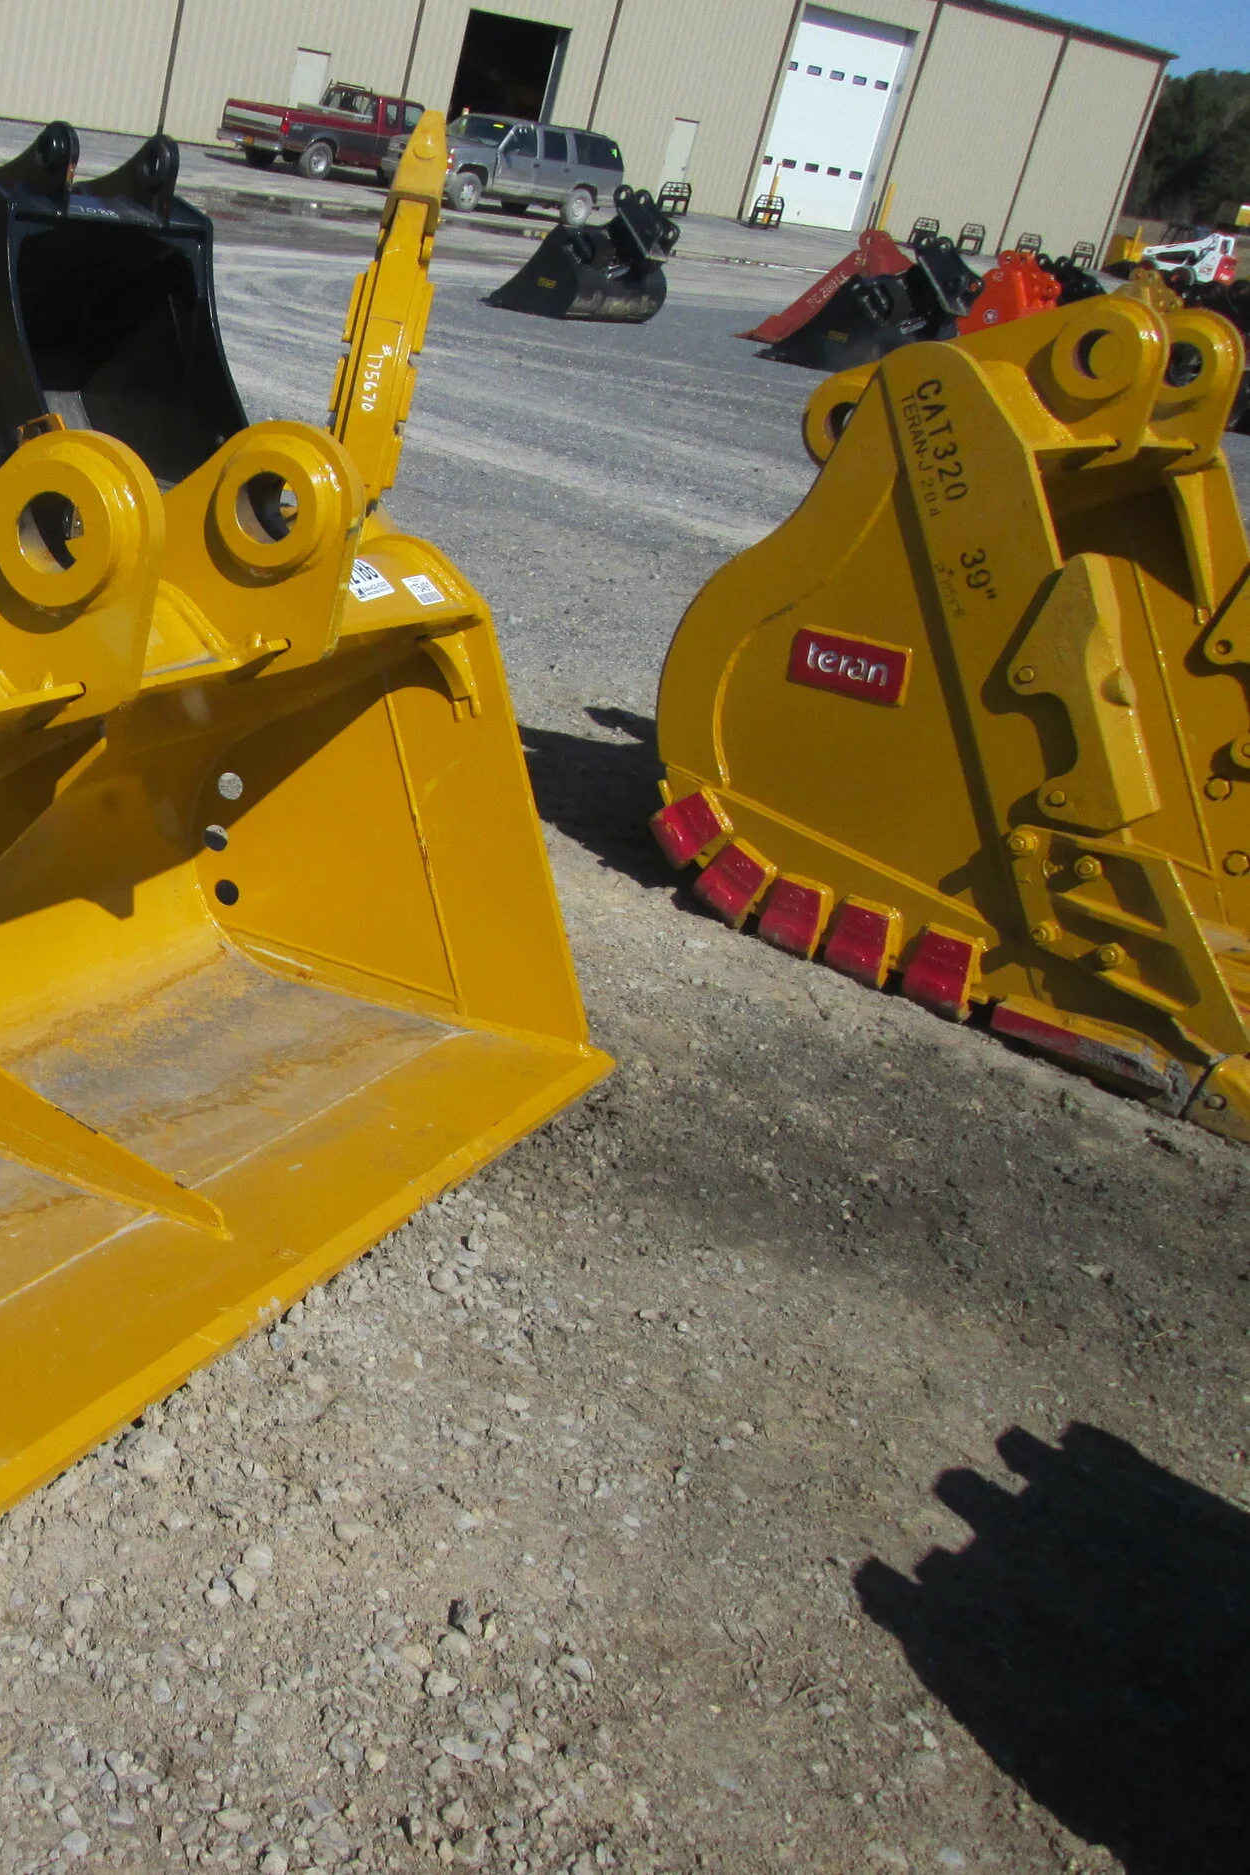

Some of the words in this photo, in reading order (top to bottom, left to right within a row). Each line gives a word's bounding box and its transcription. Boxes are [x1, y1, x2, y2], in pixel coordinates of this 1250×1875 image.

[916, 378, 968, 502] CAT320
[959, 547, 997, 600] 39"
[806, 641, 889, 688] teran
